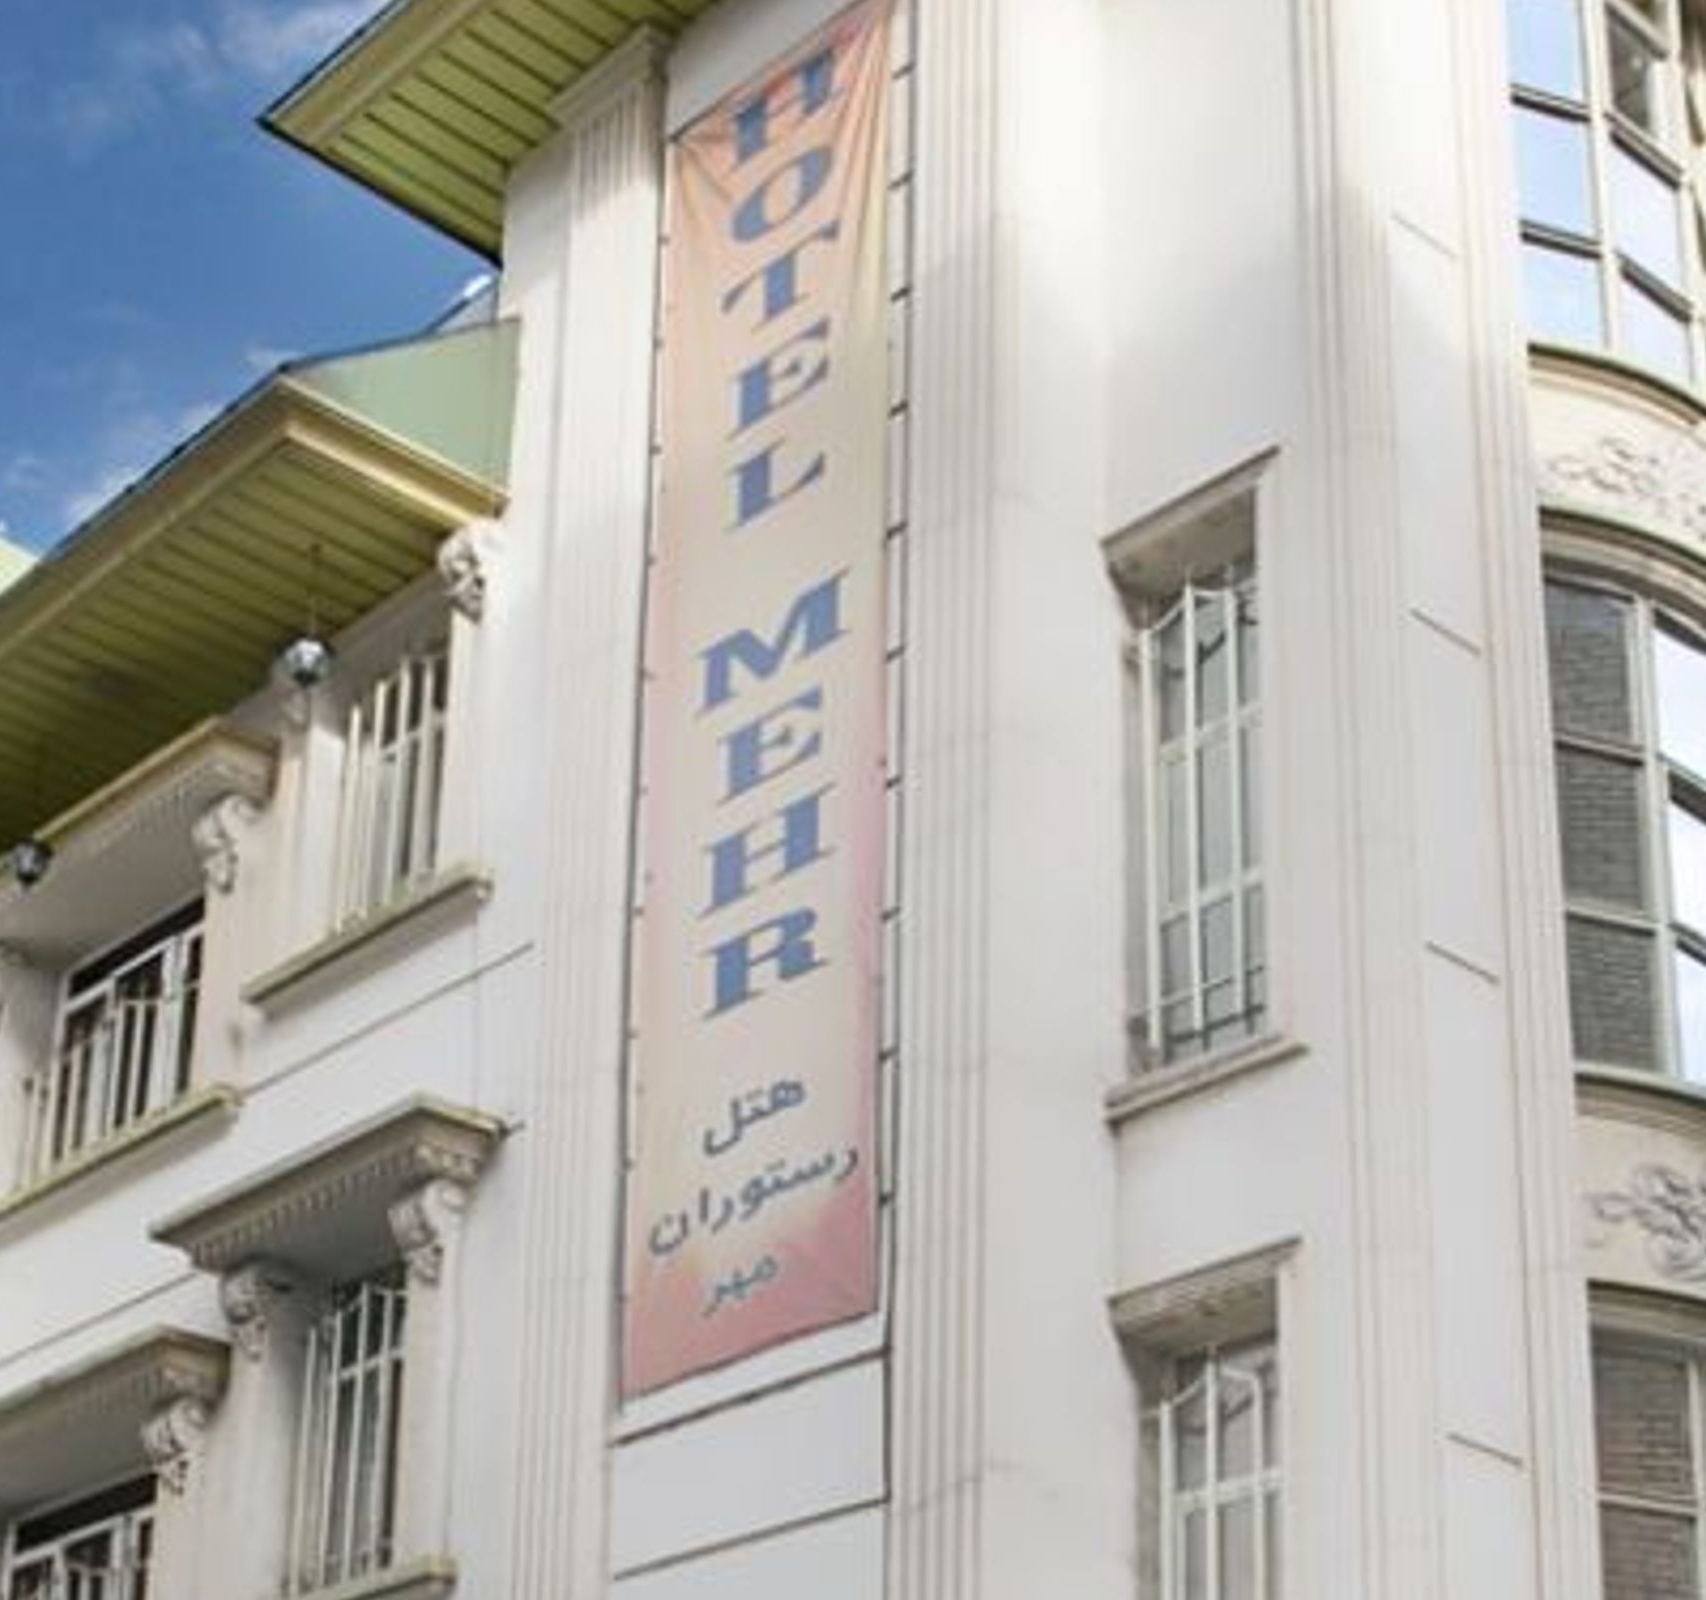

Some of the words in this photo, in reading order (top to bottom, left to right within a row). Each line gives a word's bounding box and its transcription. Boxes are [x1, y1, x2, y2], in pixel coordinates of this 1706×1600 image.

[722, 46, 842, 531] HOTEL
[695, 568, 851, 1020] MEHR
[702, 1079, 807, 1157] هتل
[648, 1147, 859, 1256] رستوران
[702, 1255, 779, 1317] مهر
